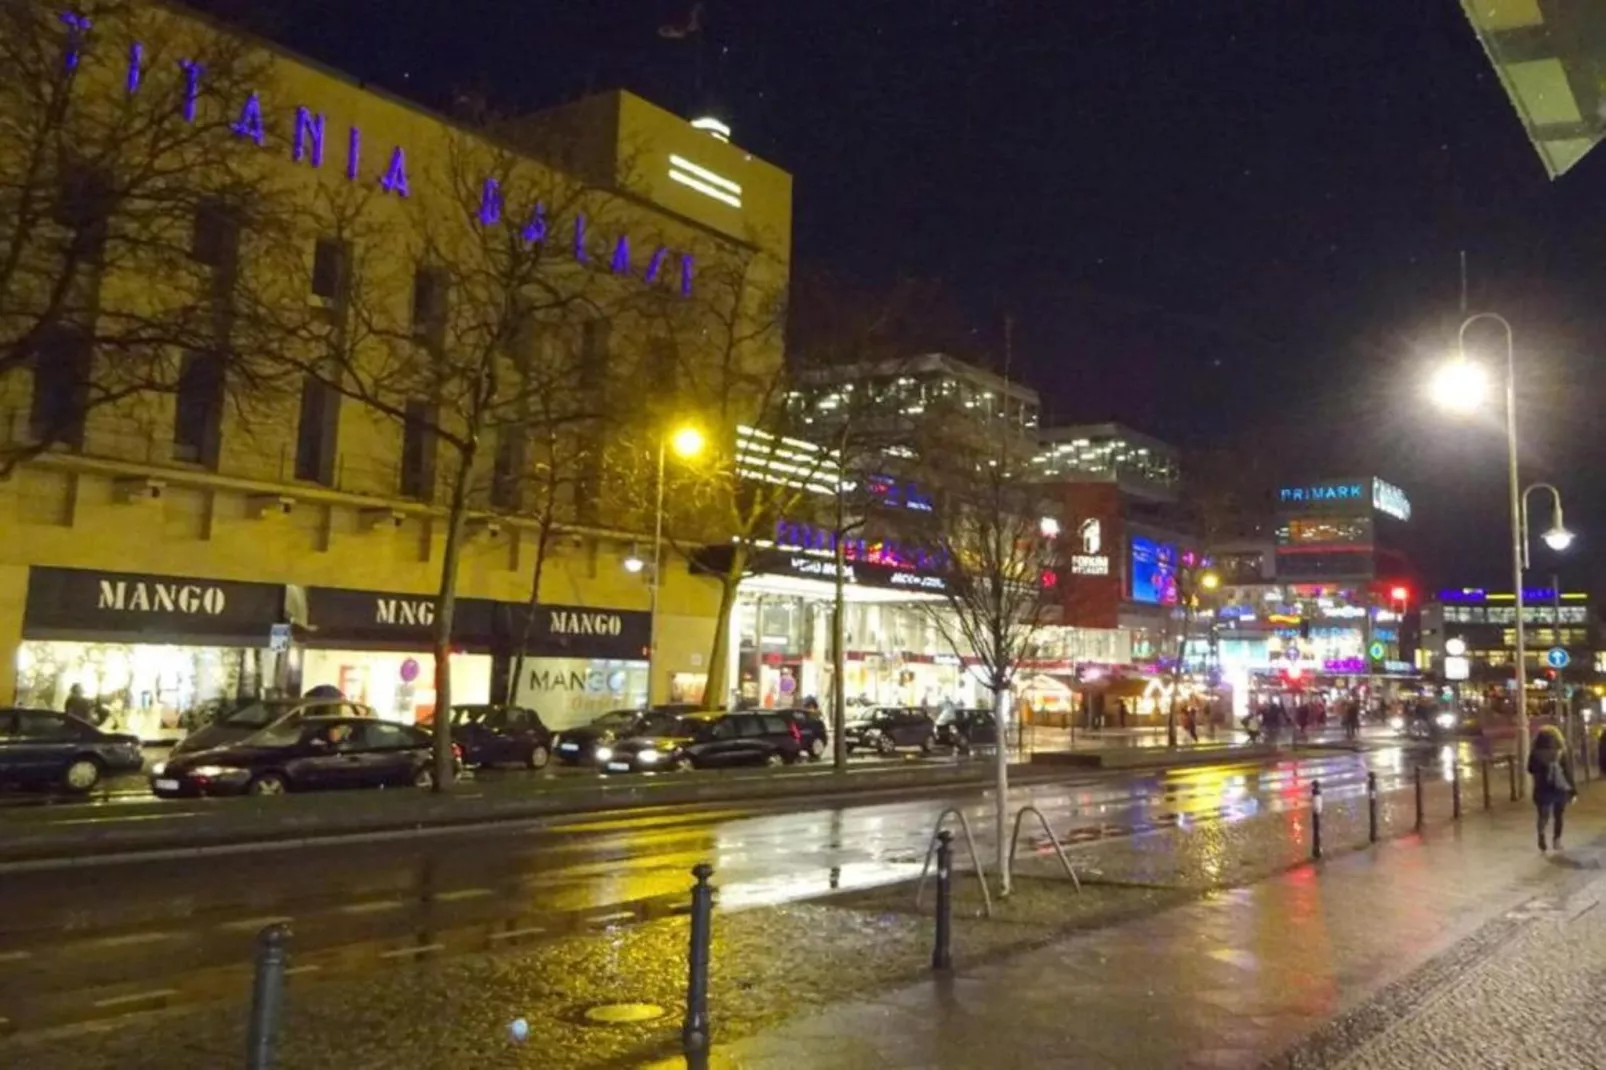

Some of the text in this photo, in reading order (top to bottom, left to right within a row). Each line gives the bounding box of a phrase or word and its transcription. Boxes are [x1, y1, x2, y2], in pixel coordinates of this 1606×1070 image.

[59, 10, 411, 197] TITANIA
[1280, 484, 1362, 501] PRIMARK
[98, 580, 226, 615] MANGO
[376, 598, 436, 626] MNG
[550, 611, 622, 636] MANGO
[529, 669, 626, 692] MANGO
